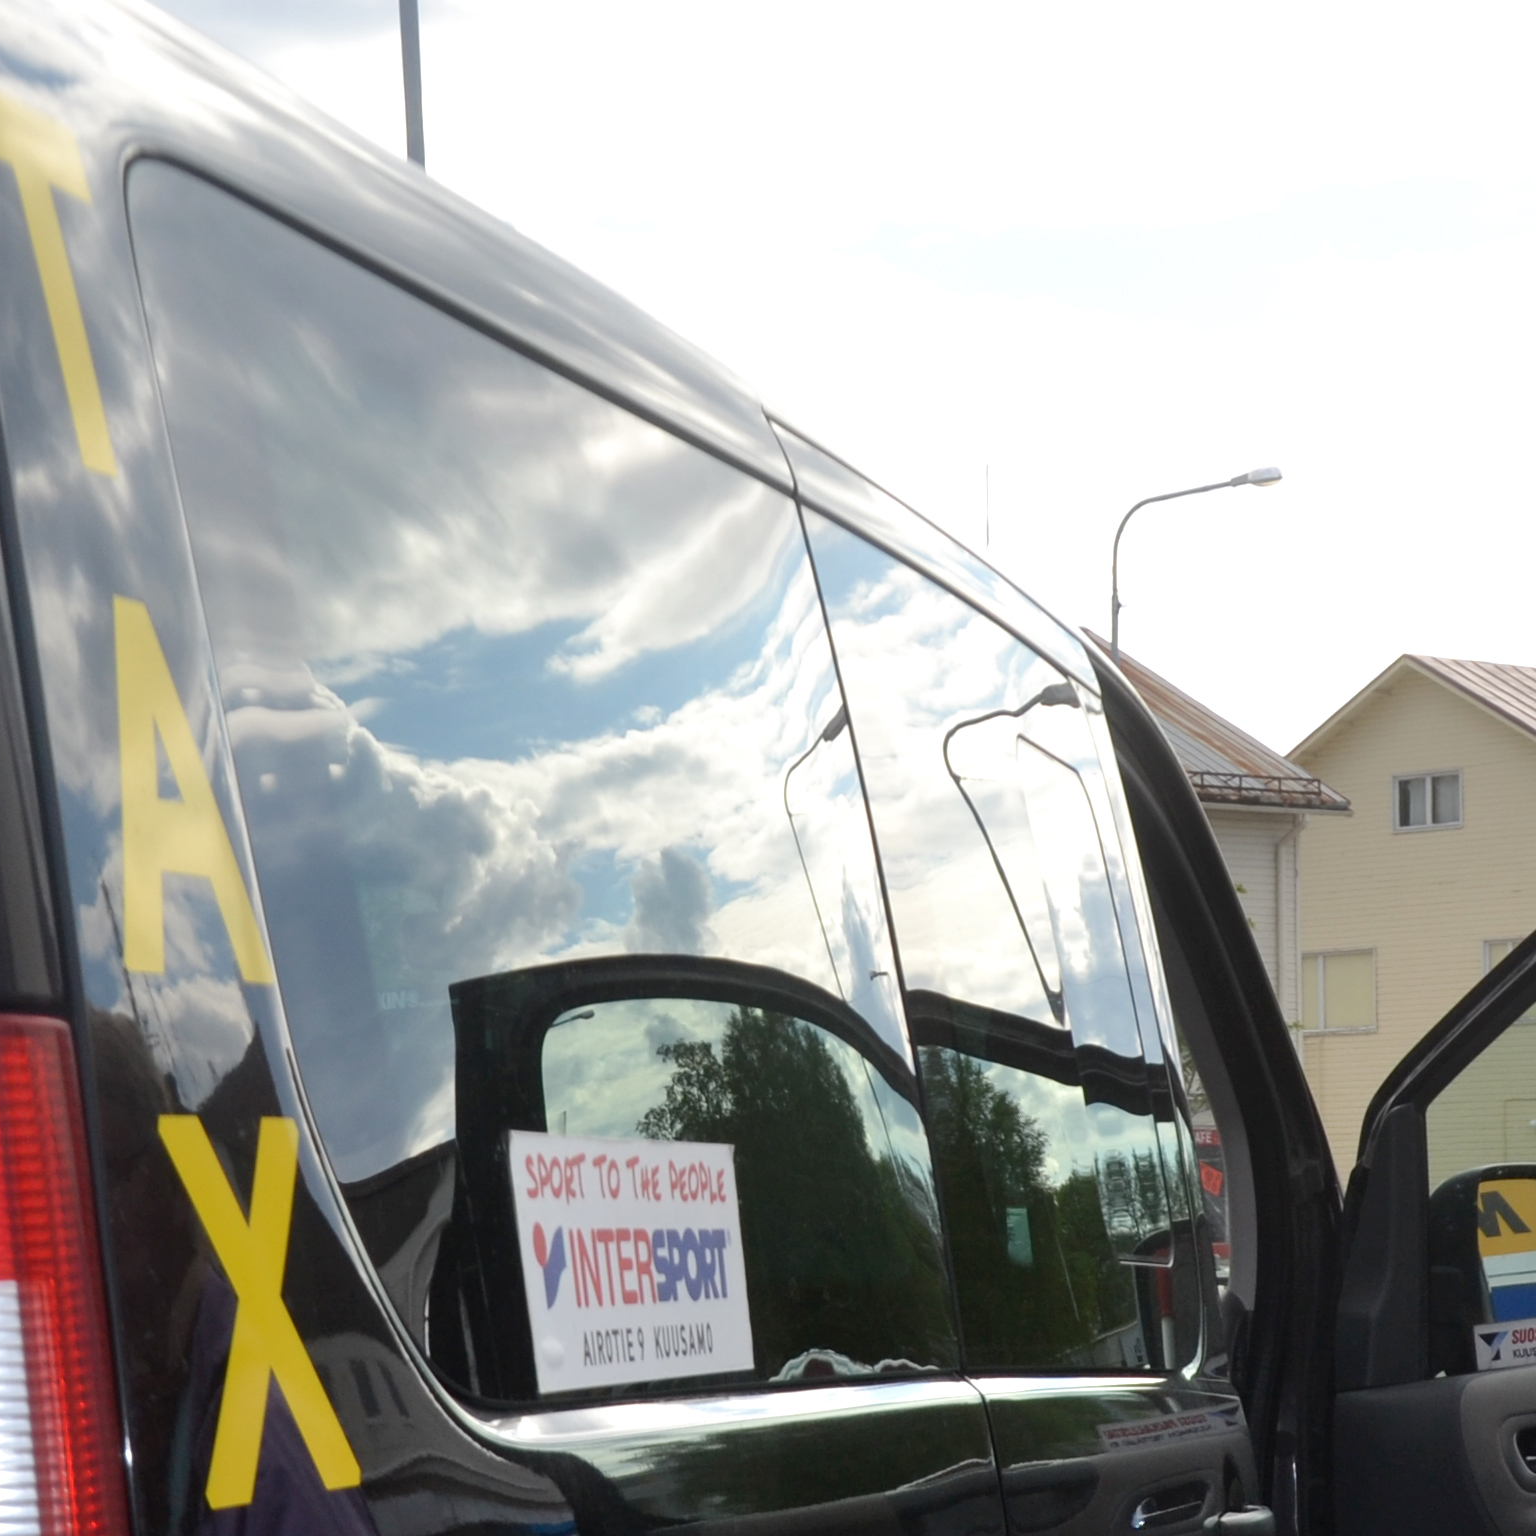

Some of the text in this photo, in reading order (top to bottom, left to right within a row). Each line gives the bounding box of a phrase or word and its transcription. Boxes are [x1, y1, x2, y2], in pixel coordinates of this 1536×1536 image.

[525, 1153, 586, 1204] SPORT
[592, 1153, 621, 1200] TO
[668, 1160, 727, 1204] PEOPLE
[568, 1227, 728, 1308] INTERSPORT
[583, 1322, 714, 1367] AIROTIE 9 KUUSAMO
